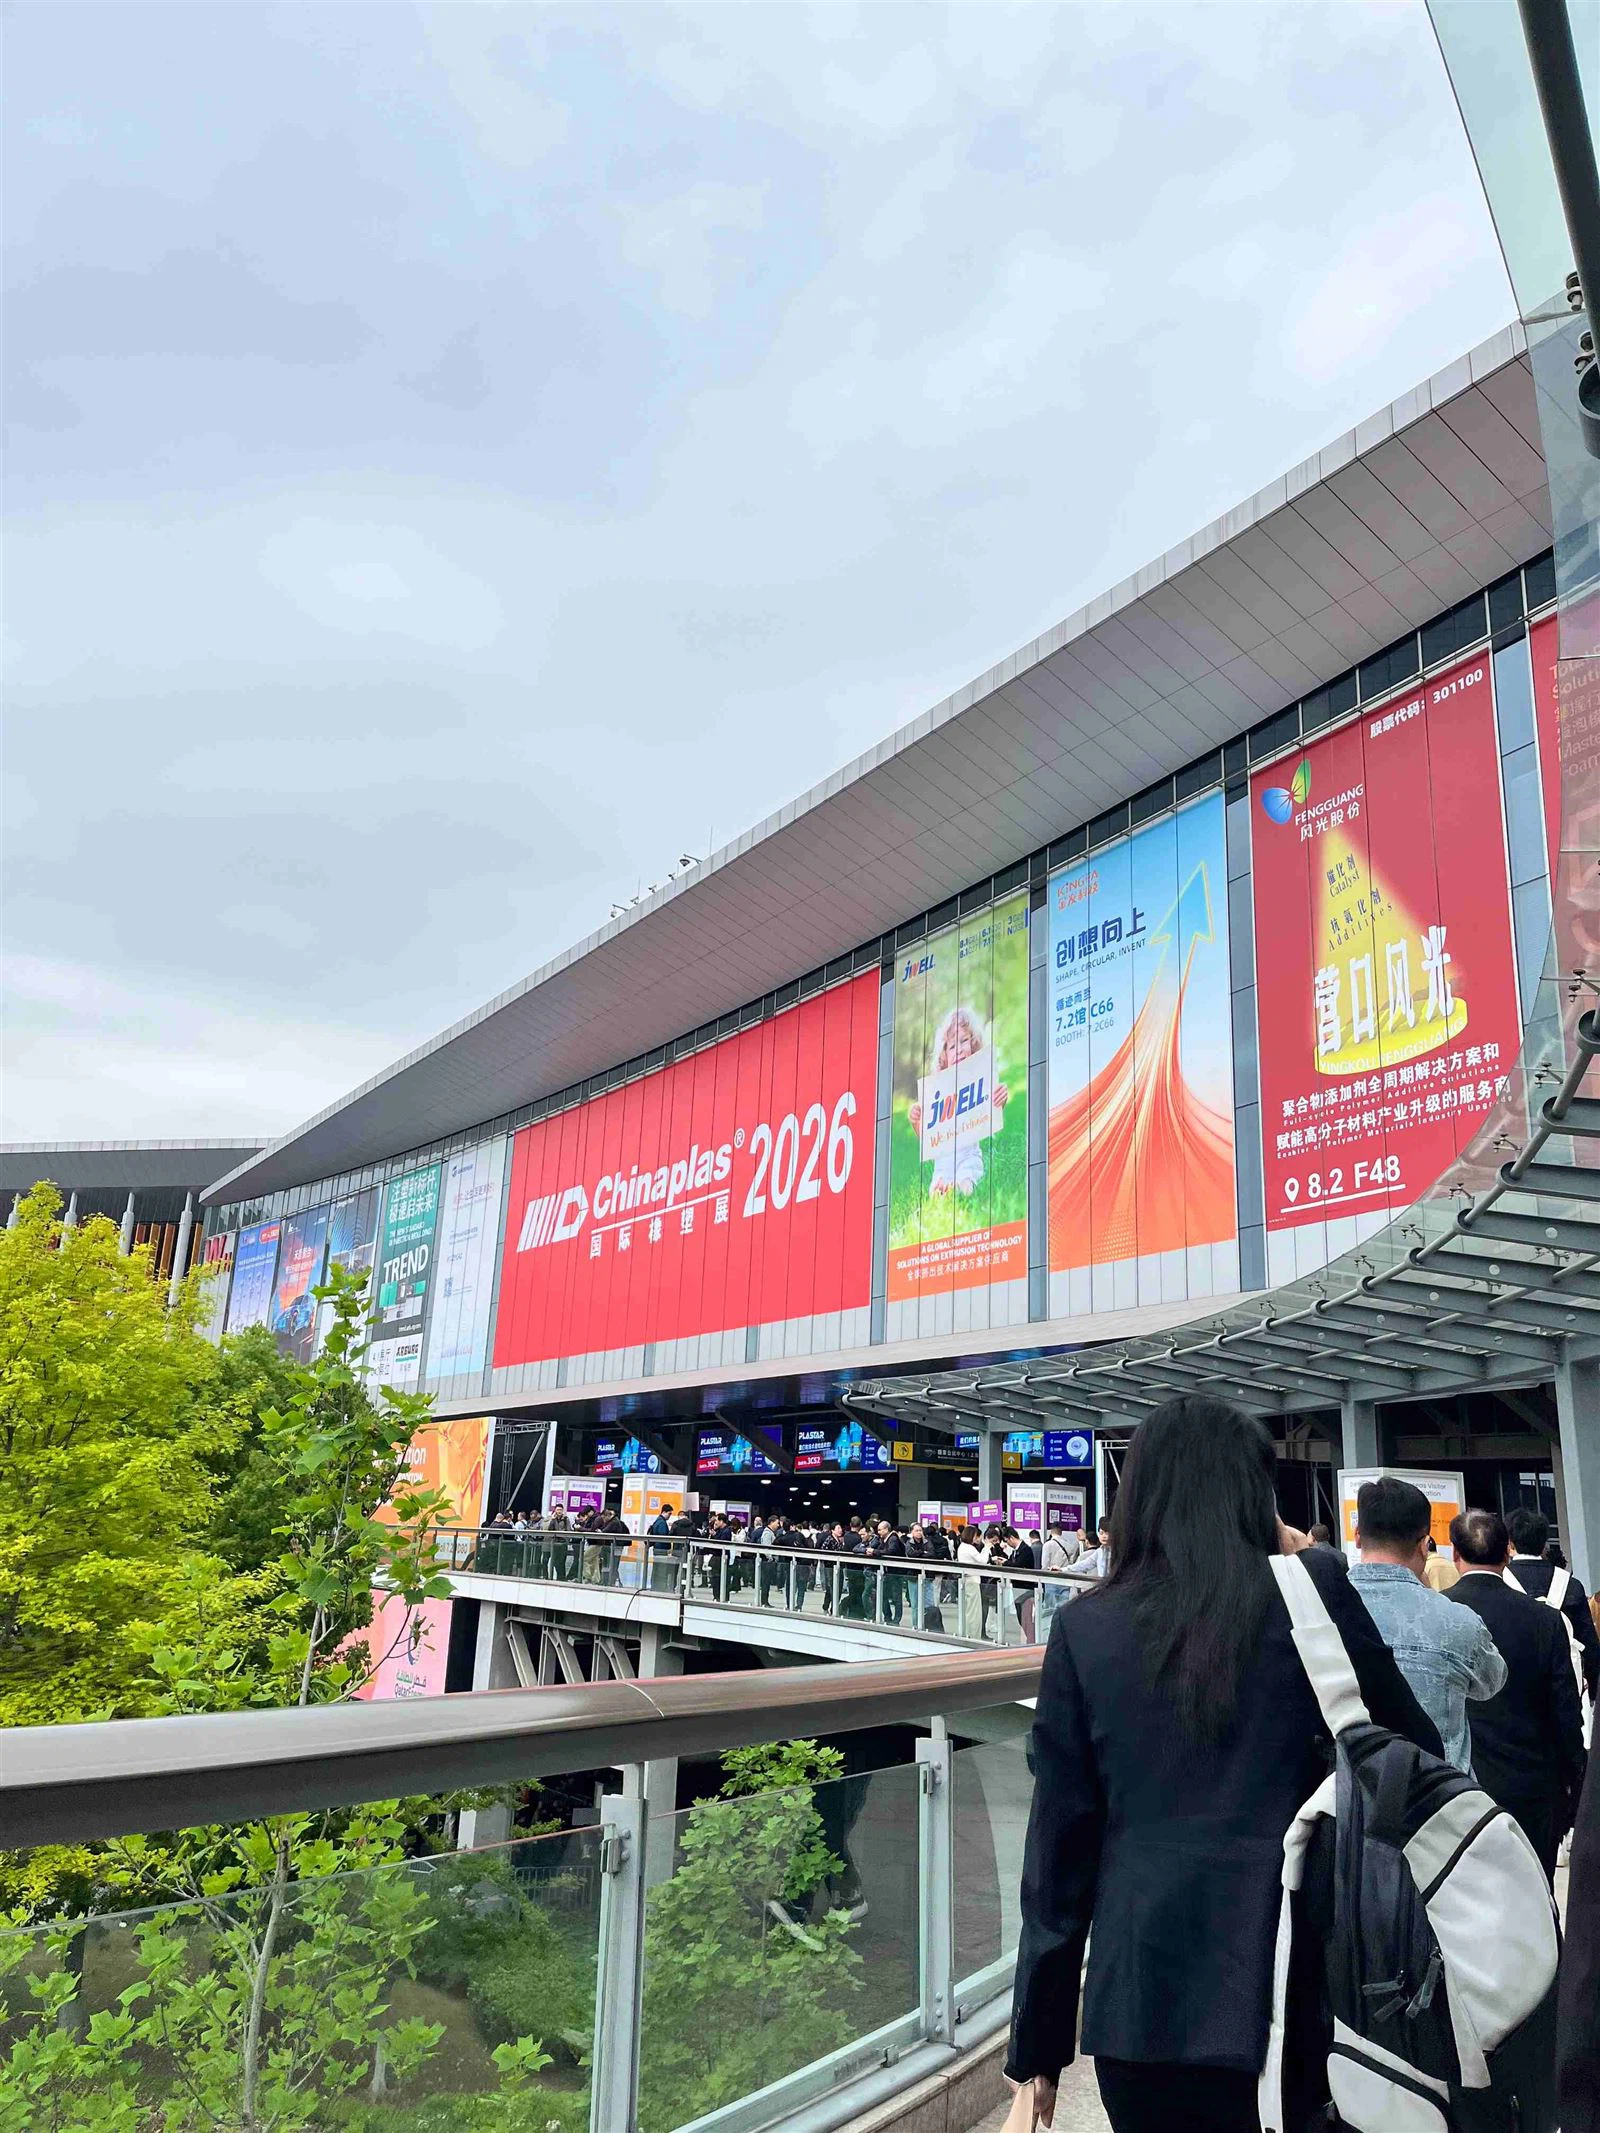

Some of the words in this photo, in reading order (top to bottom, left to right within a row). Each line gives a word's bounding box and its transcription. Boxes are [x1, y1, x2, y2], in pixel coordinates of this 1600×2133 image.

[1433, 669, 1483, 704] 301100
[1295, 783, 1364, 826] FENGGUANG
[1301, 801, 1361, 842] 风光股份
[1330, 868, 1360, 897] Catalyst
[1331, 888, 1381, 934] 抗氧化剂
[1056, 907, 1147, 968] 创想向上
[1055, 968, 1079, 984] SHAPE,
[1081, 951, 1116, 973] CIRCULAR,
[1119, 937, 1146, 957] INVENT
[1314, 925, 1457, 1057] 营口风光
[1055, 1007, 1087, 1033] 7.2馆
[1090, 997, 1114, 1018] C66
[1282, 1042, 1500, 1117] 聚合物添加剂全周期解决方案和
[1283, 1109, 1335, 1126] Full-cycle
[1340, 1097, 1382, 1112] Polymer
[1387, 1082, 1434, 1099] Additive
[1441, 1065, 1500, 1085] Solutions
[1277, 1076, 1511, 1152] 赋能高分子材料产业升级的服务商
[743, 1091, 857, 1219] 2026
[1327, 1133, 1363, 1147] Polymer
[1307, 1168, 1344, 1199] 8.2
[1354, 1155, 1401, 1189] F48
[589, 1194, 730, 1260] 国际橡塑展
[921, 1245, 926, 1254] A
[926, 1241, 951, 1252] GLOBAL
[952, 1234, 982, 1248] SUPPLIER
[983, 1231, 991, 1241] OF
[383, 1244, 429, 1284] TREND
[896, 1255, 929, 1270] SOLUTIONS
[930, 1253, 940, 1263] ON
[941, 1245, 976, 1260] EXTRUSION
[977, 1235, 1023, 1252] TECHNOLOGY
[798, 1431, 825, 1440] PLASTAR
